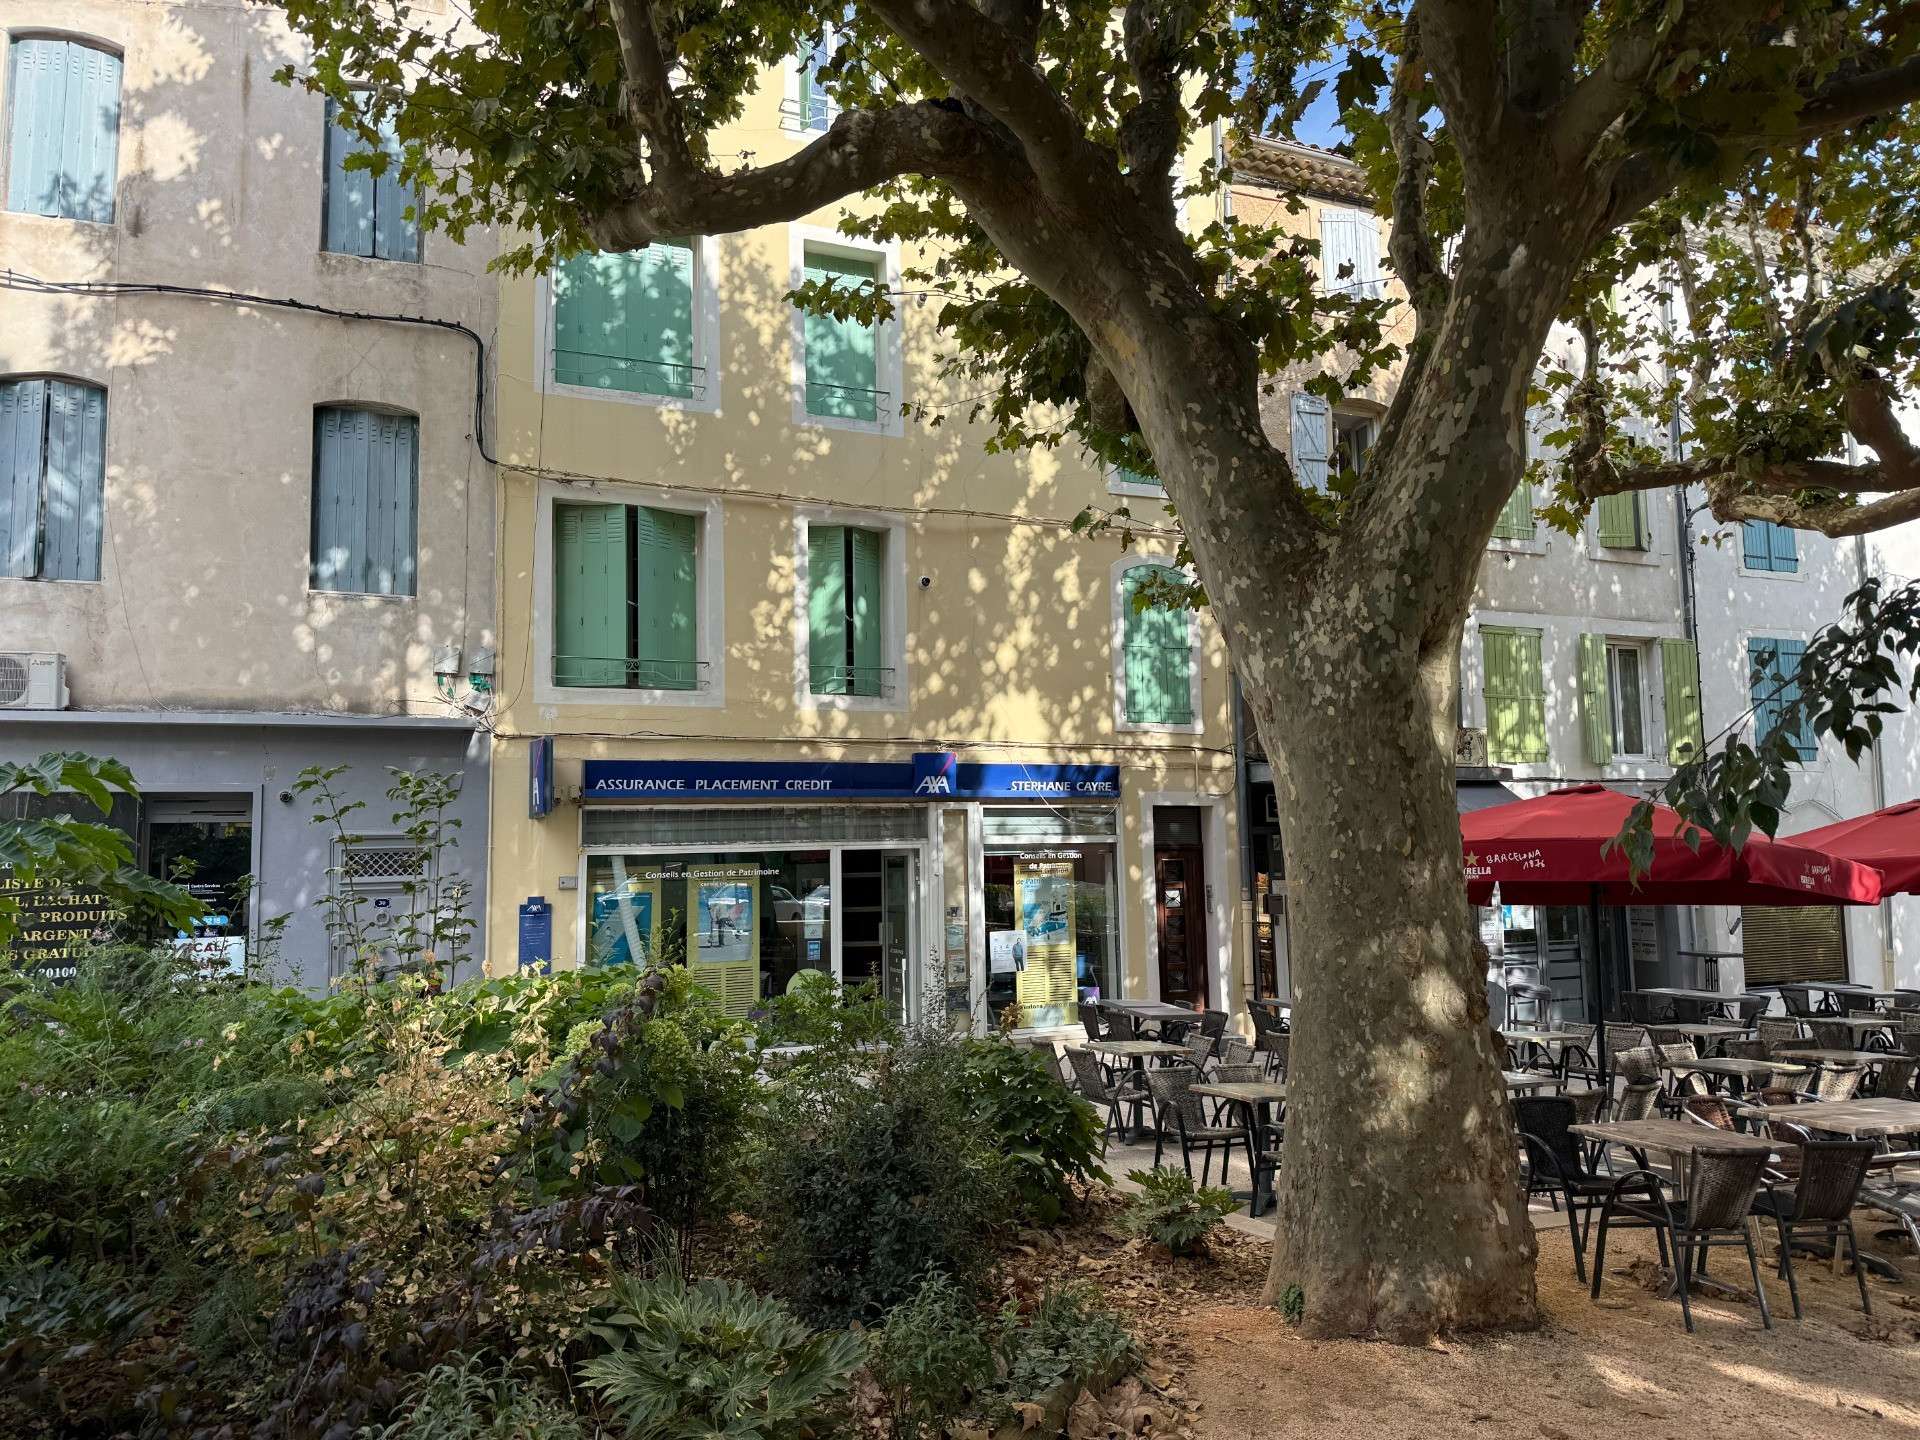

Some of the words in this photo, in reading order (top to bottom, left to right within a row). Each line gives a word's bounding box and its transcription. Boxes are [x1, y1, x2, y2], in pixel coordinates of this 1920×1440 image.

[595, 779, 685, 791] ASSURANCE
[695, 779, 779, 791] PLACEMENT
[785, 779, 833, 791] CREDIT
[915, 775, 950, 794] AXA
[1010, 781, 1071, 792] STEPHANE
[1076, 781, 1112, 792] CAYRE
[1057, 852, 1083, 860] Gestion
[1485, 848, 1541, 864] BARCELONA
[1028, 862, 1038, 870] de
[645, 871, 679, 879] Conseils
[693, 869, 724, 878] Gestion
[726, 869, 737, 877] de
[738, 868, 780, 877] Patrimoine
[40, 910, 128, 924] PRODUITS
